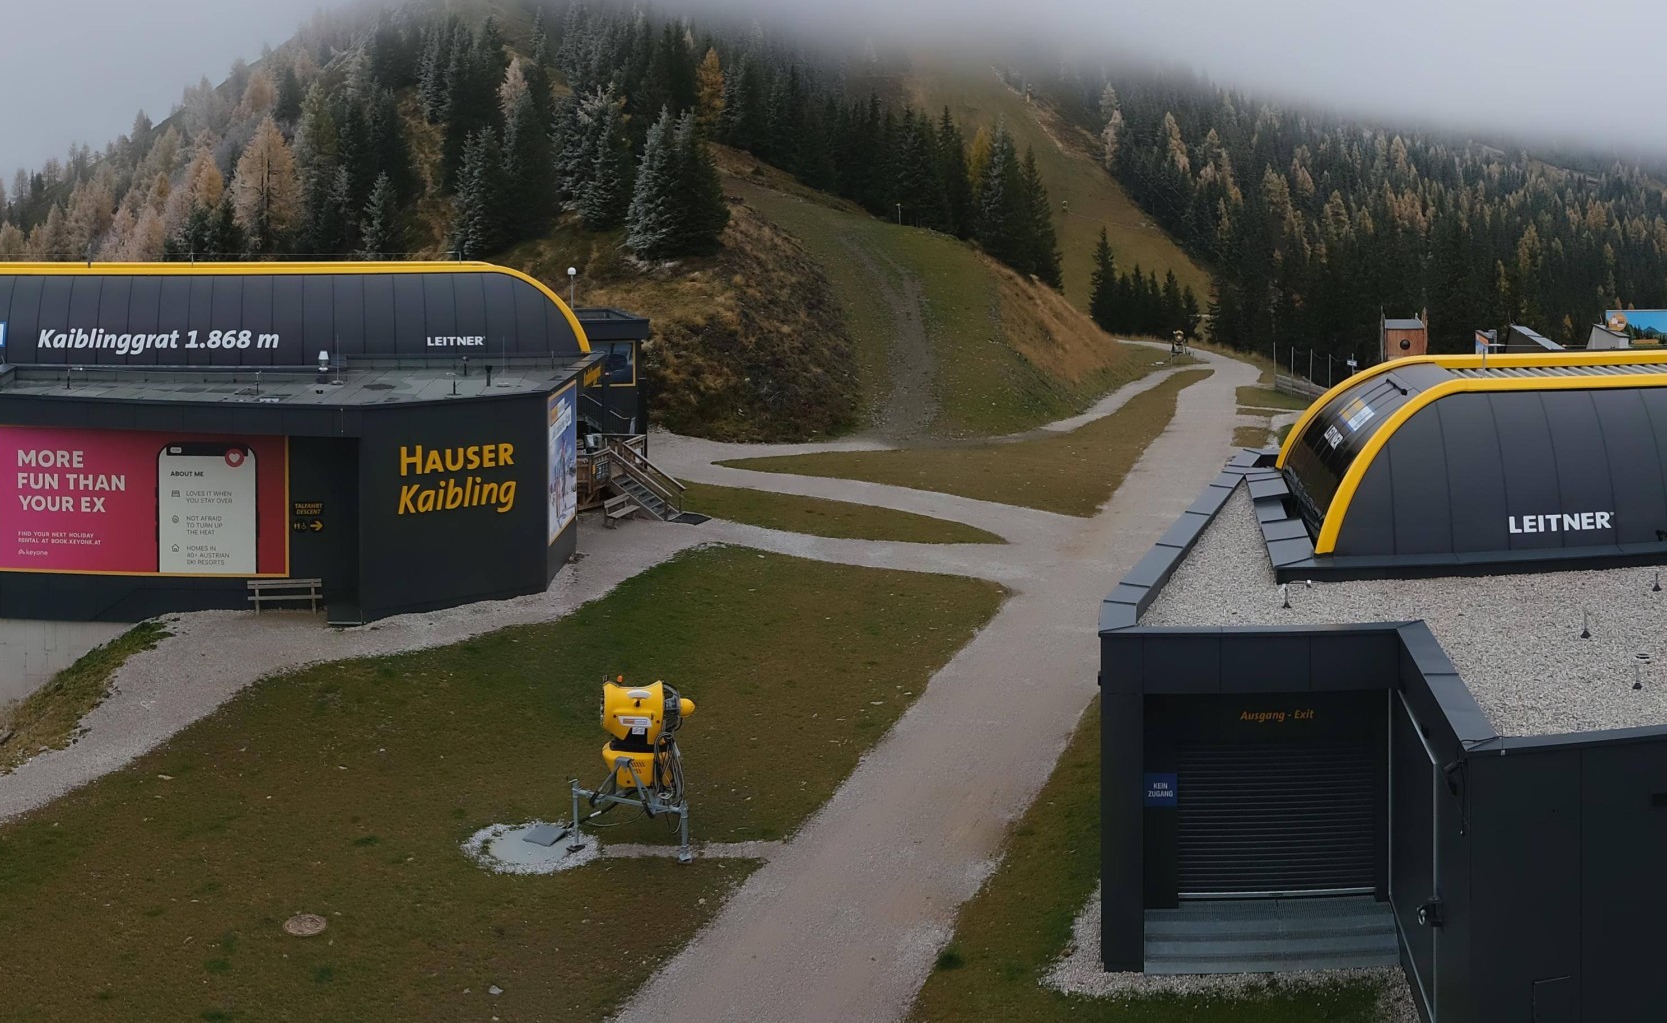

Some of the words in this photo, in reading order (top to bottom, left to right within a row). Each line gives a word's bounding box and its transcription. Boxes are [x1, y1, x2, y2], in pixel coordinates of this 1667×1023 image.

[37, 328, 180, 355] Kaiblinggrat
[184, 330, 252, 349] 1.868
[256, 332, 280, 349] m
[17, 449, 84, 468] MORE
[400, 443, 515, 477] HAUSER
[17, 473, 59, 489] FUN
[66, 474, 126, 491] THAN
[19, 495, 75, 512] YOUR
[81, 497, 106, 513] EX
[398, 477, 517, 515] Kaibling
[1240, 711, 1285, 722] Ausgang
[1294, 709, 1314, 719] Exit
[1148, 790, 1173, 798] ZUGANG
[1153, 782, 1168, 790] KEIN
